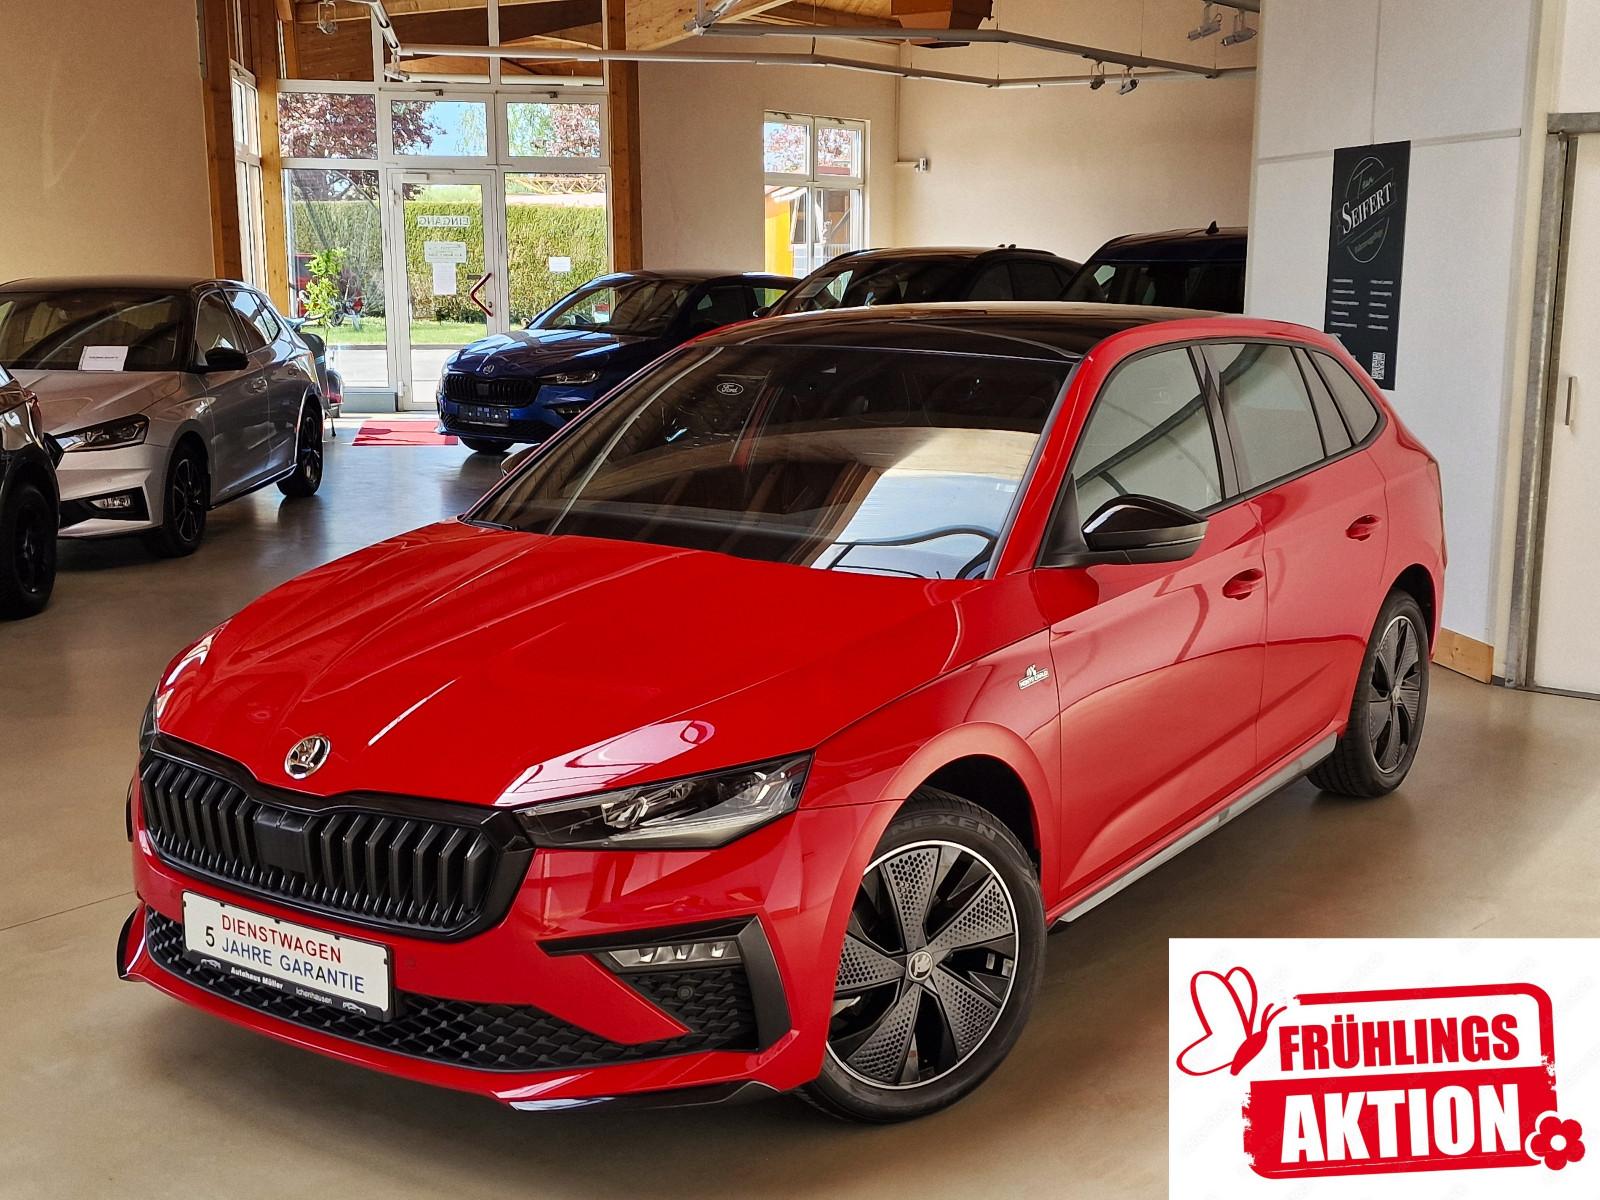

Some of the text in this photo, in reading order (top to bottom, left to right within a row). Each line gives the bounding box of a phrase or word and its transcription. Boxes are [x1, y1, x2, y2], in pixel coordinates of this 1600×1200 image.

[892, 814, 996, 840] NEXEN
[221, 914, 342, 964] DIENSTWAGEN
[205, 925, 365, 994] 5 JAHRE GARANTIE
[230, 966, 262, 983] Autohaus
